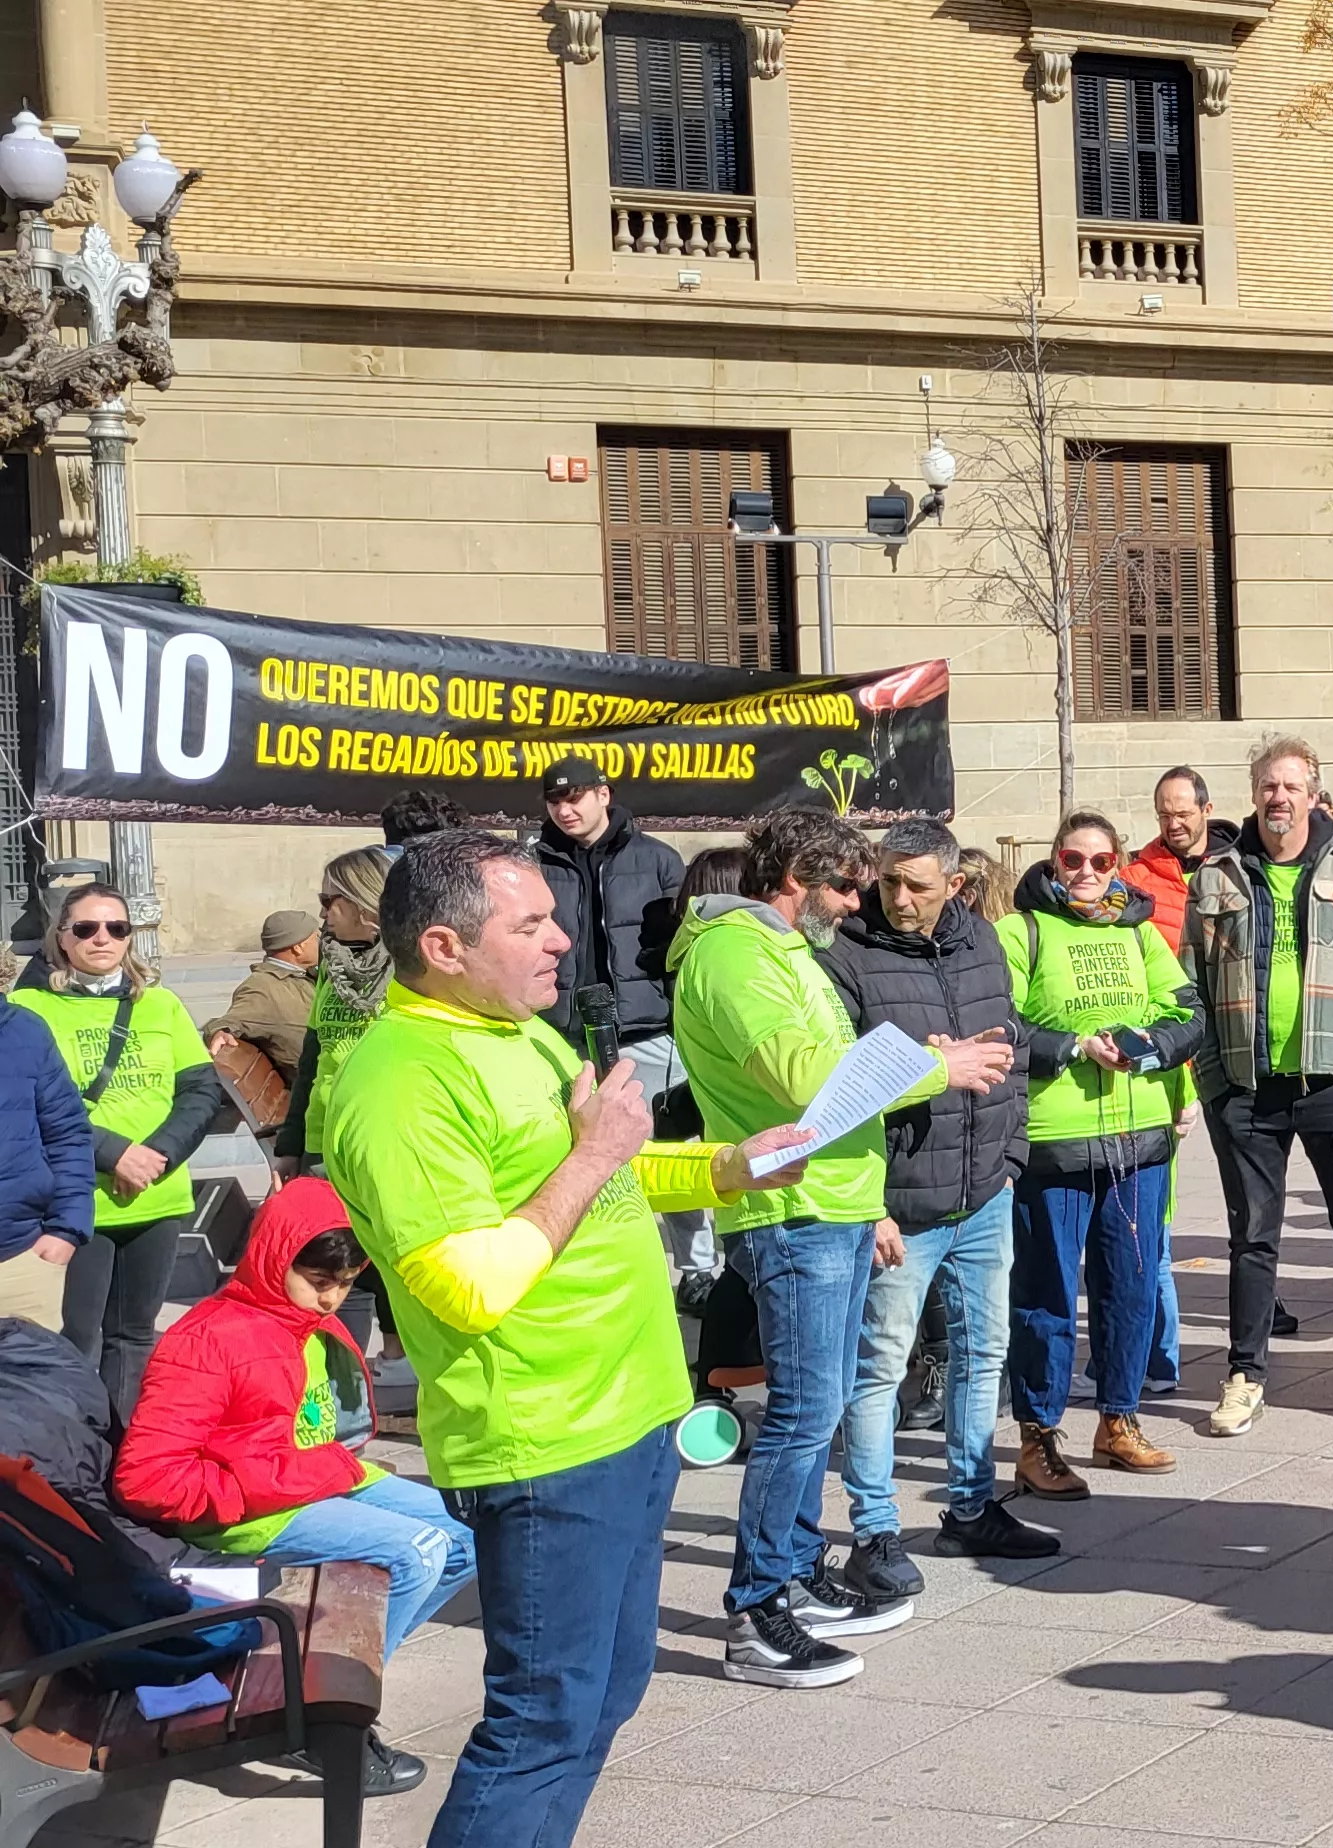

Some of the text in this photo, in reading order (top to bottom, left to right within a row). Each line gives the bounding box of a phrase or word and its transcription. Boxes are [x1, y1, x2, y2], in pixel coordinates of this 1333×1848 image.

[62, 620, 233, 780] NO
[260, 657, 440, 715] QUEREMOS
[447, 677, 505, 720] QUE
[511, 685, 547, 725] SE
[257, 722, 321, 768] LOS
[328, 729, 478, 777] REGADÍOS
[482, 740, 518, 777] DE
[627, 743, 646, 778] Y
[650, 743, 756, 780] SALILLAS
[1067, 943, 1126, 959] PROYECTO
[1084, 957, 1129, 972] INTERES
[1076, 972, 1133, 991] GENERAL
[1065, 994, 1099, 1014] PARA
[1102, 992, 1133, 1007] QUIEN
